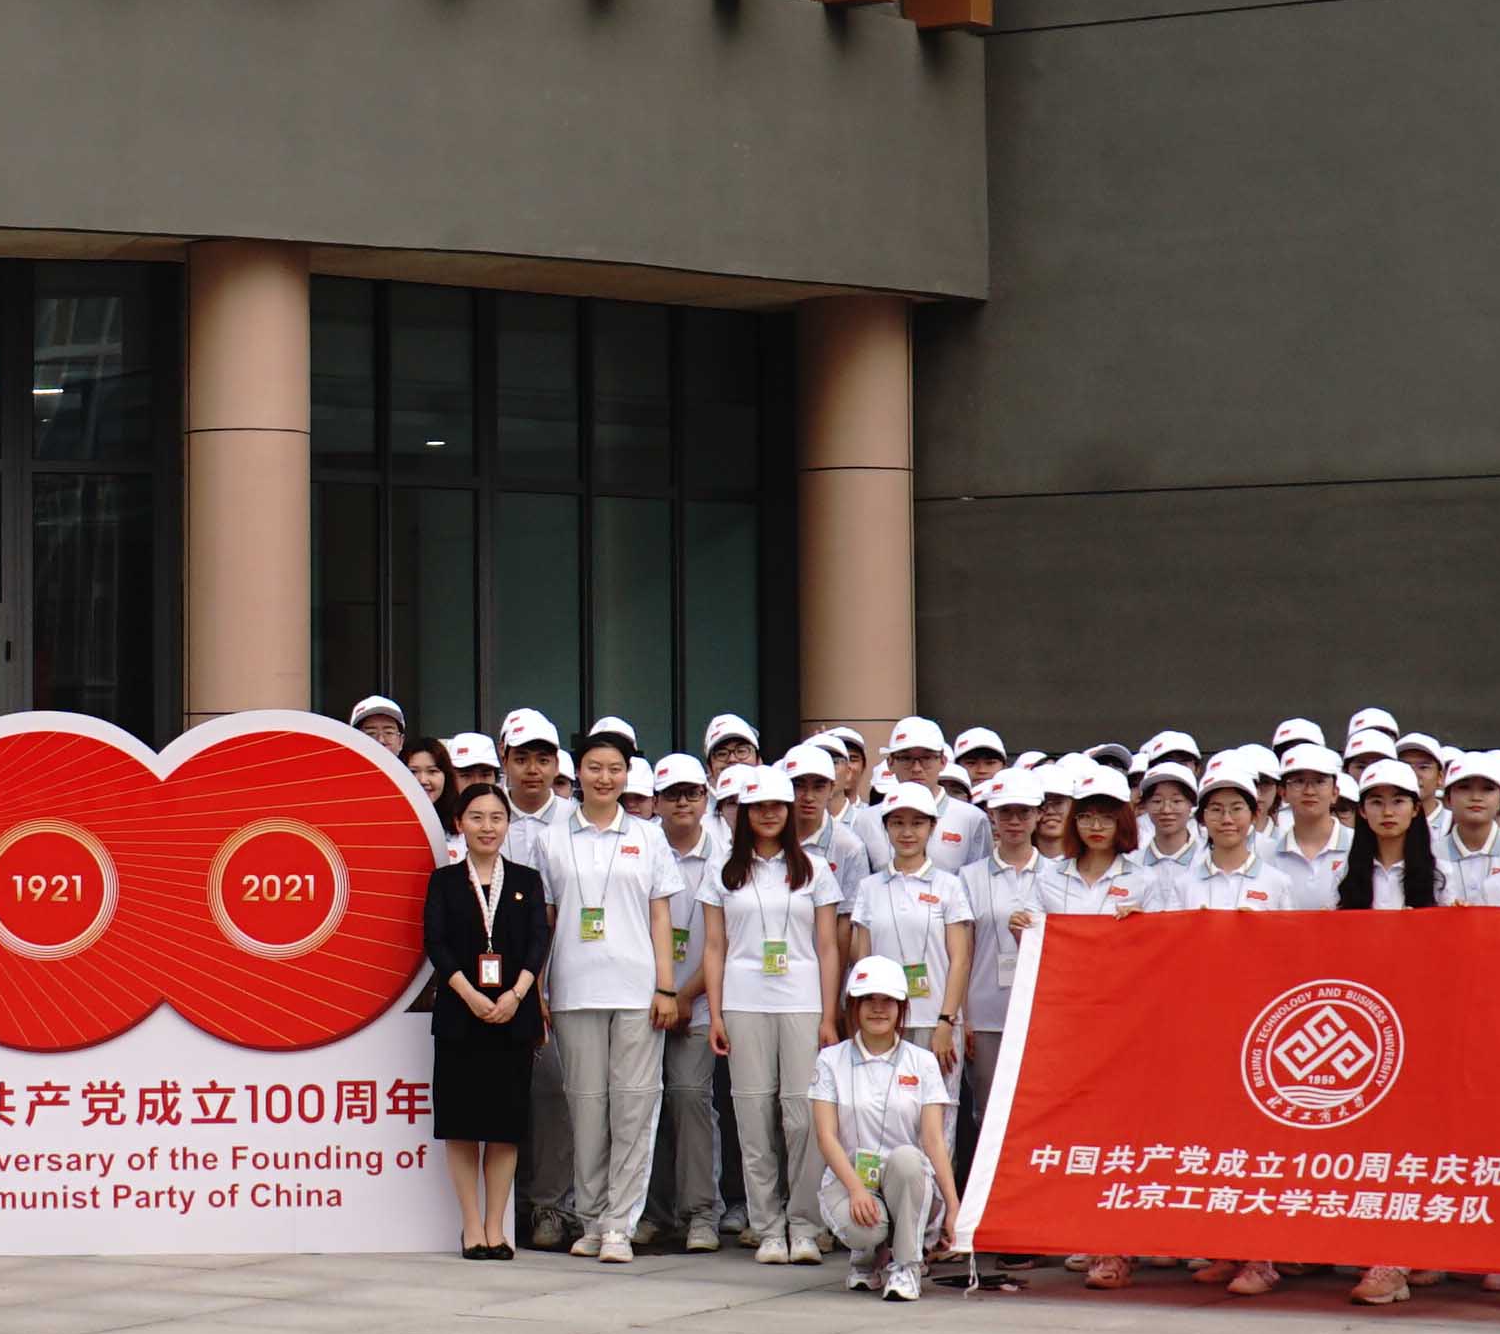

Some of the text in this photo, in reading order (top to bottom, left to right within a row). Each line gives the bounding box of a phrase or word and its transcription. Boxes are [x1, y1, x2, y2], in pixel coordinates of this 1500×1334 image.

[12, 874, 83, 902] 1921
[241, 874, 316, 902] 2021
[1318, 987, 1342, 998] AND
[1345, 990, 1388, 1024] BUSINESS
[127, 1147, 159, 1170] of
[169, 1147, 219, 1170] the
[231, 1145, 383, 1176] Founding
[395, 1144, 427, 1169] of
[113, 1184, 195, 1215] Party
[208, 1183, 240, 1208] of
[250, 1183, 343, 1208] China
[1097, 1182, 1494, 1224] 北京工商大学志愿服务队
